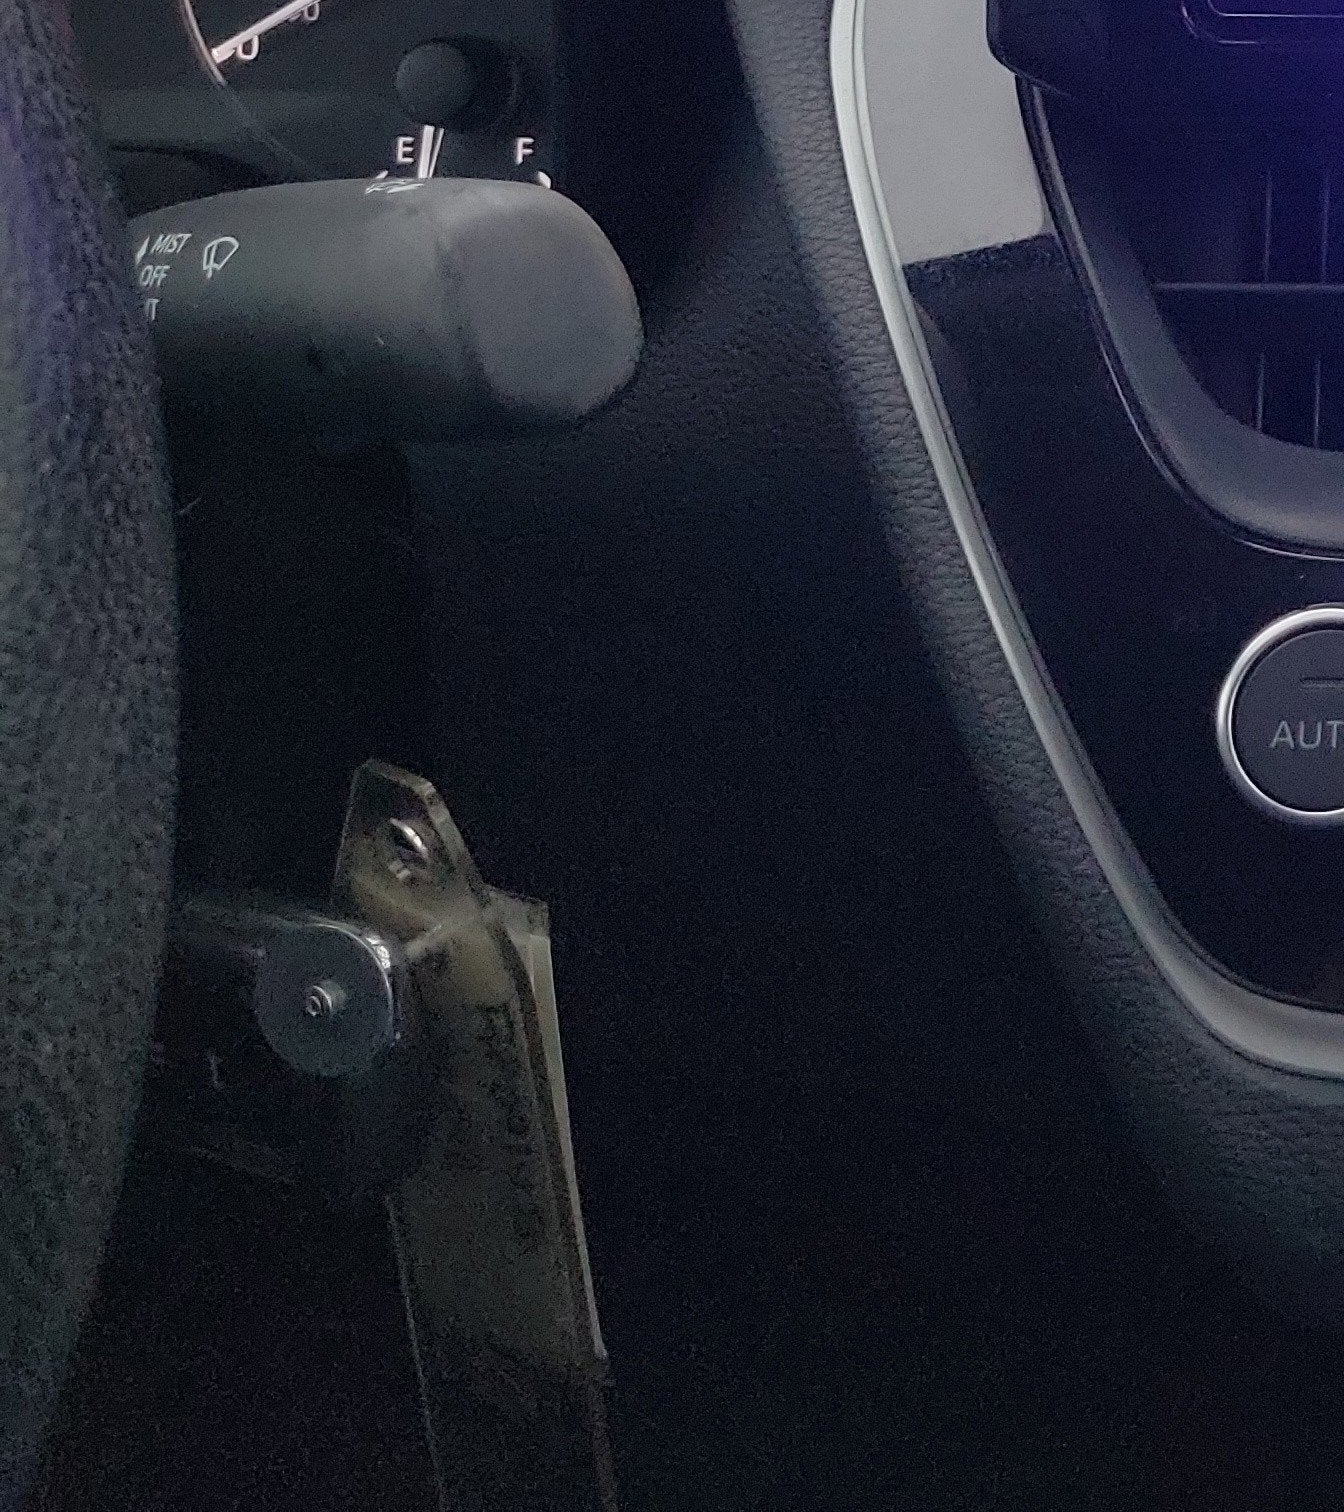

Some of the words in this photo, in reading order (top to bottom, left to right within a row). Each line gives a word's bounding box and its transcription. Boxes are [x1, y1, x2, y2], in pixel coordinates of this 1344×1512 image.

[396, 136, 415, 163] E
[515, 137, 534, 164] F
[151, 232, 192, 255] MIST
[140, 264, 170, 287] OFF
